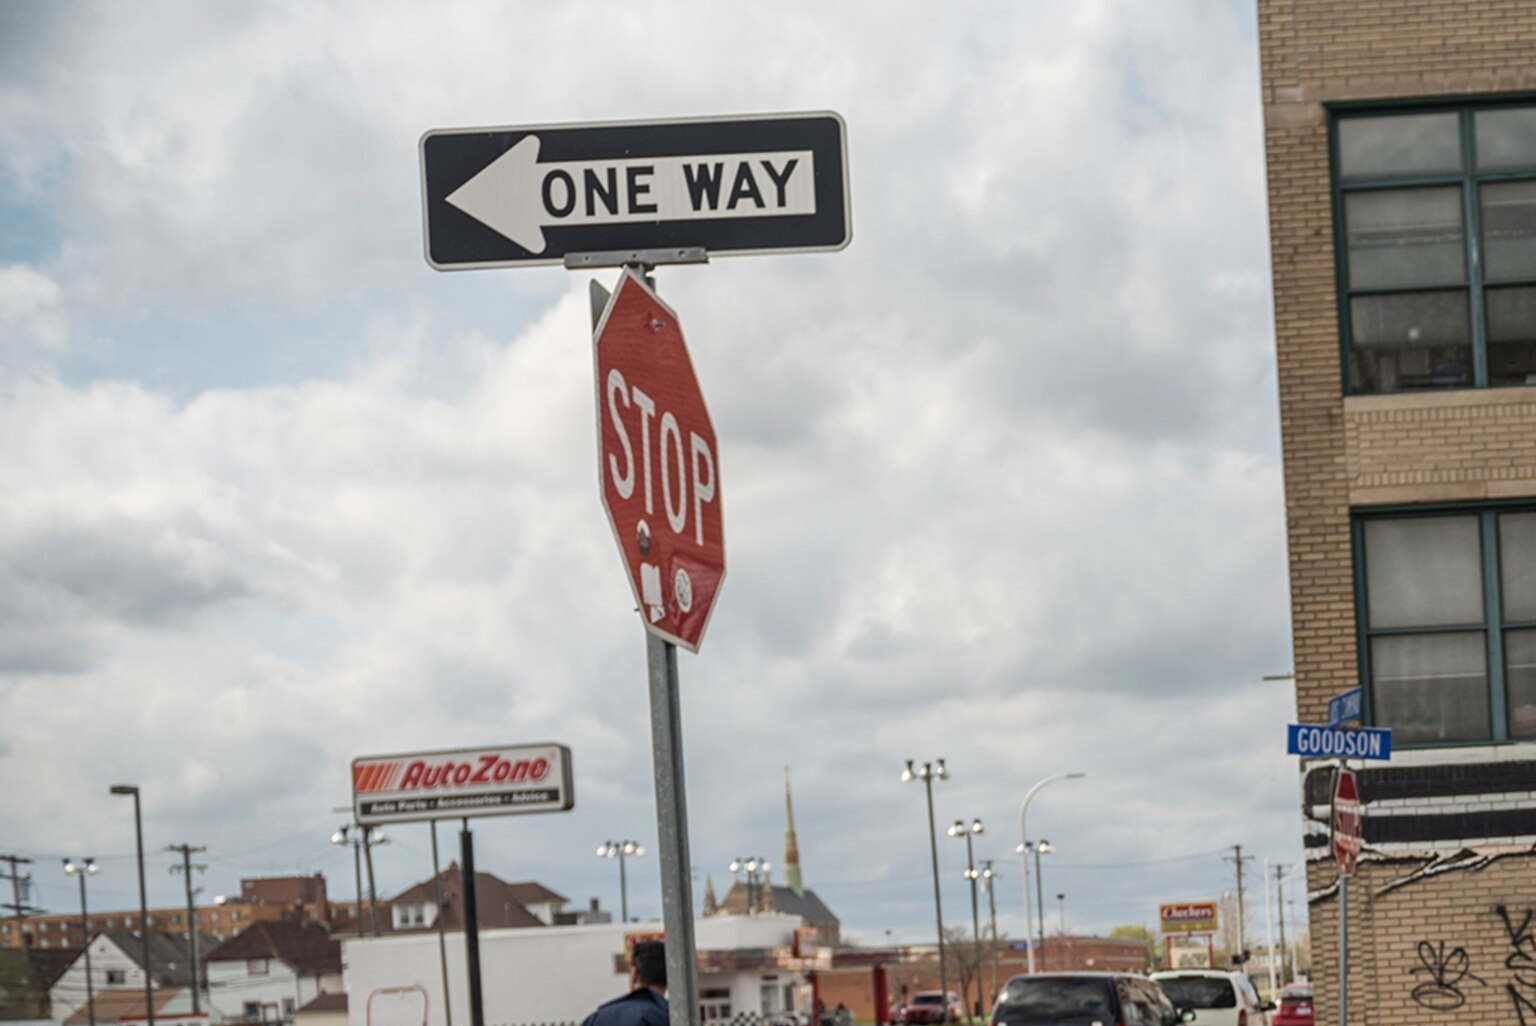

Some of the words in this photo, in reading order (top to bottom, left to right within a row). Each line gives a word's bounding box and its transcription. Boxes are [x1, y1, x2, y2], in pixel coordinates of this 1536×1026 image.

[541, 165, 659, 219] ONE
[682, 158, 800, 213] WAY
[606, 368, 716, 547] STOP
[1297, 728, 1381, 756] GOODSON
[399, 753, 548, 791] AutoZone
